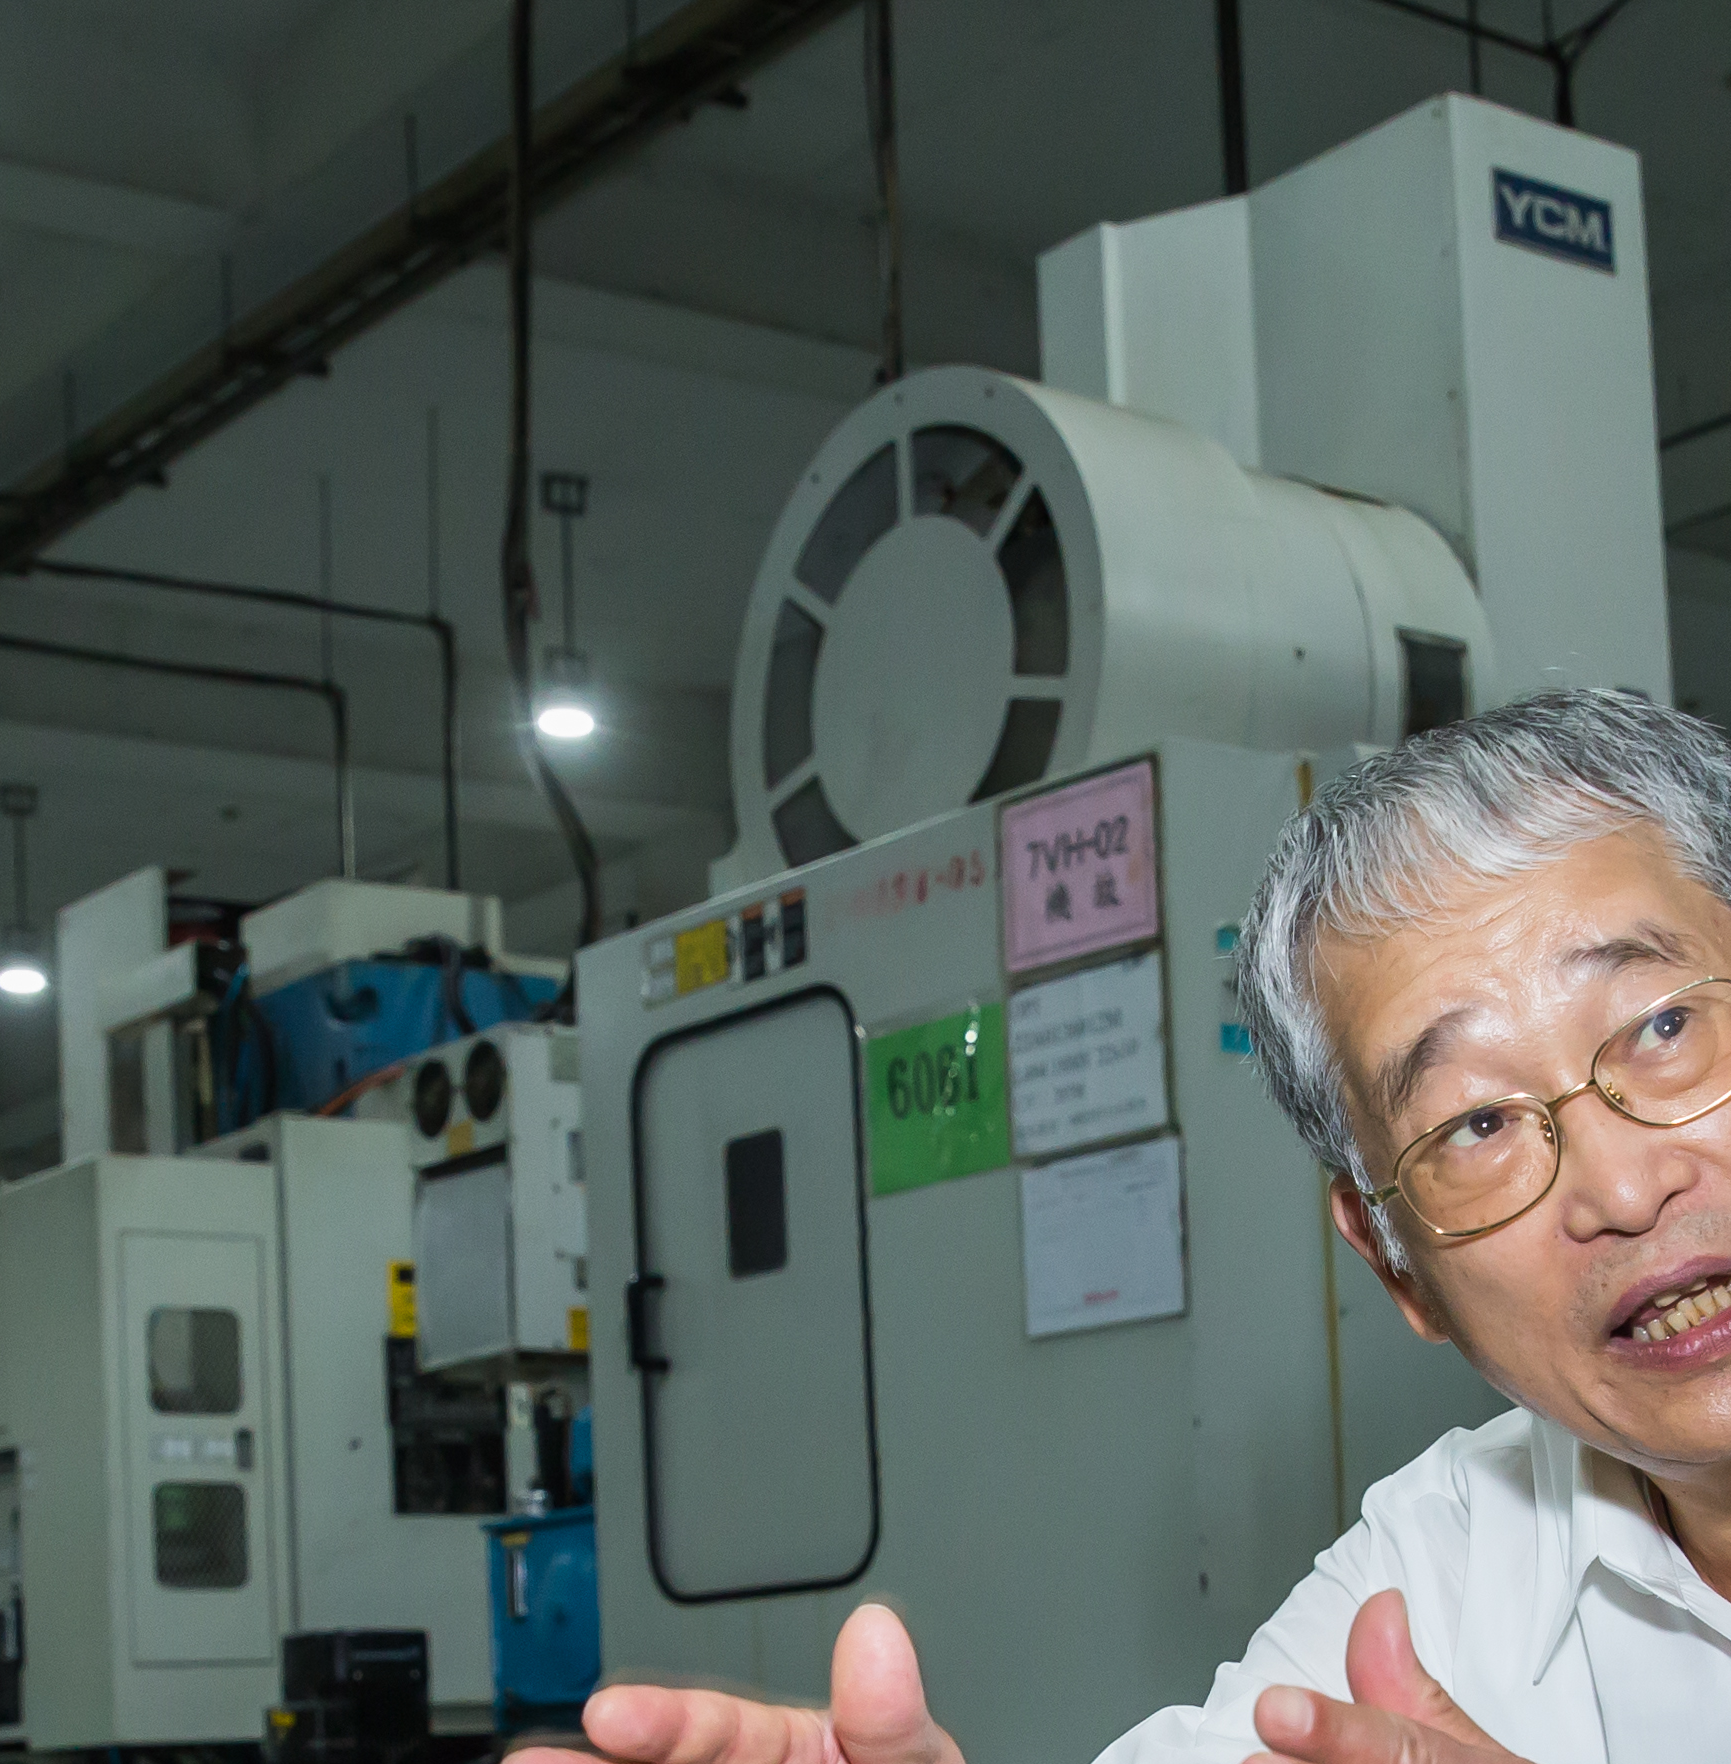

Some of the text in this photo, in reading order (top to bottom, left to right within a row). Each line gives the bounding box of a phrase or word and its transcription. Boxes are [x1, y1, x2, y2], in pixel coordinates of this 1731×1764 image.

[1500, 185, 1609, 252] YCM
[1027, 815, 1130, 880] 7VH-02
[887, 1044, 980, 1121] 6061
